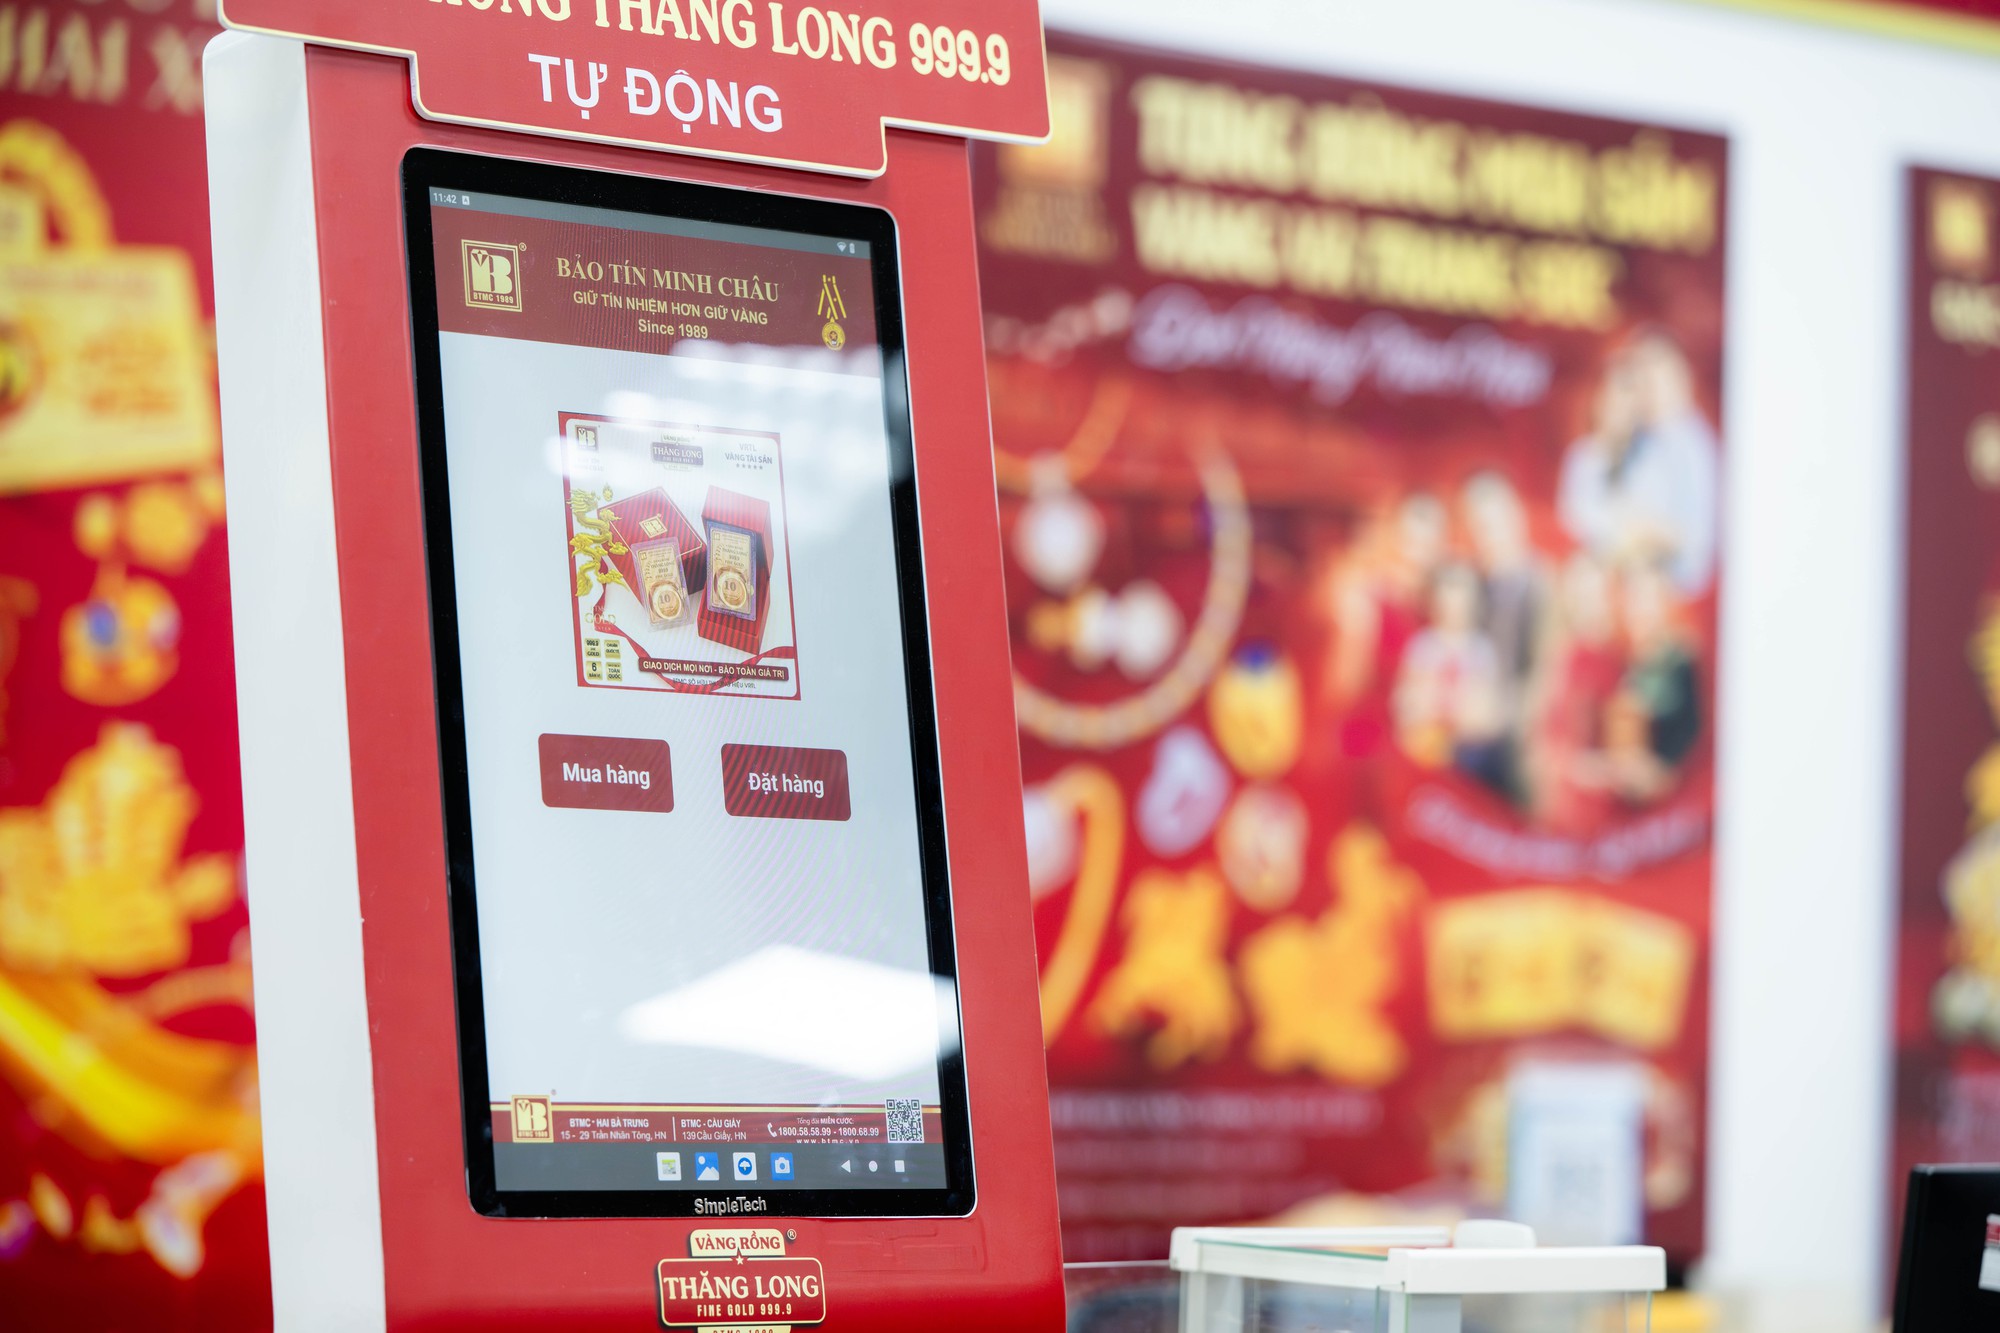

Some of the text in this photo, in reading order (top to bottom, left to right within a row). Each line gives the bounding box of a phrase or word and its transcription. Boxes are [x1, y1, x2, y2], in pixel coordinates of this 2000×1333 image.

[768, 2, 897, 69] LONG
[908, 22, 1011, 86] 999.9
[528, 53, 783, 134] TỰ ĐỘNG
[433, 192, 457, 204] 11:42
[556, 253, 779, 302] BẢO TÍN MINH CHÂU
[473, 292, 514, 304] BTMC 1989
[573, 290, 769, 325] GIỮ TÍN NHIỆM HƠN GIỮ VÀNG
[638, 318, 708, 340] Since 1989
[724, 451, 746, 462] VÀNG
[725, 580, 737, 592] 10
[659, 593, 671, 604] 10
[591, 662, 598, 672] 6
[643, 660, 662, 670] GIAO
[664, 662, 682, 673] DỊCH
[683, 664, 698, 674] MỌI
[699, 665, 713, 673] NƠI
[737, 665, 757, 677] TOÀN
[758, 667, 772, 677] GIÁ
[772, 669, 786, 680] TRỊ
[562, 762, 650, 789] Mua hàng
[748, 772, 824, 798] Đặt hàng
[569, 1118, 591, 1128] BTMC
[596, 1118, 609, 1127] HAI
[610, 1116, 622, 1128] BÀ
[681, 1119, 702, 1128] BTMC
[579, 1131, 590, 1140] 29
[654, 1131, 667, 1139] HN
[682, 1131, 697, 1140] 139
[734, 1132, 747, 1140] HN
[778, 1126, 832, 1137] 1800.58.58.99
[838, 1127, 880, 1137] 1800.68.99
[694, 1196, 767, 1216] SimpleTech
[695, 1231, 781, 1250] VÀNG RỒNG
[663, 1270, 819, 1300] THĂNG LONG
[697, 1303, 792, 1317] FINE GOLD 999.9
